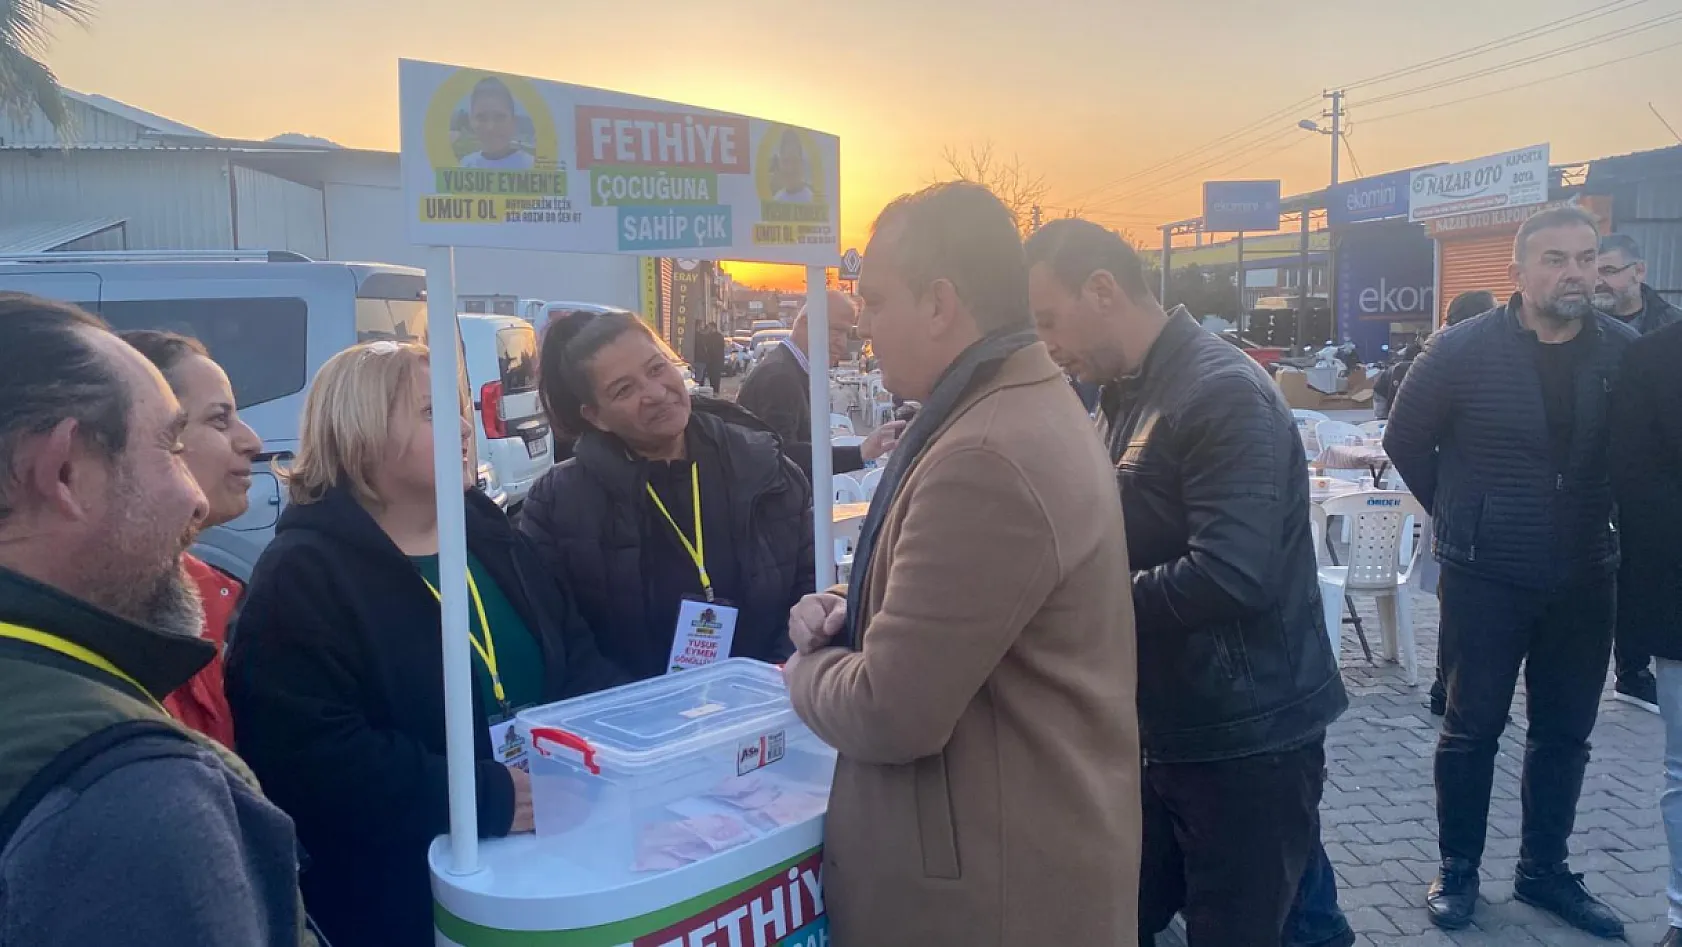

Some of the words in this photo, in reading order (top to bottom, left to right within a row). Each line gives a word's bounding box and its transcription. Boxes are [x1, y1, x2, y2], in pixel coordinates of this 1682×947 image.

[591, 116, 738, 164] FETHİYE
[443, 170, 496, 193] YUSUF
[500, 172, 562, 194] EYMEN'E
[597, 171, 710, 206] ÇOCUĞUNA
[1346, 180, 1396, 210] ekomini
[1427, 170, 1472, 196] NAZAR
[1474, 164, 1502, 186] OTO
[426, 198, 474, 219] UMUT
[477, 198, 497, 219] OL
[1469, 211, 1490, 228] OTO
[624, 208, 688, 241] SAHİP
[694, 214, 727, 246] ÇIK
[673, 272, 698, 283] ERAY
